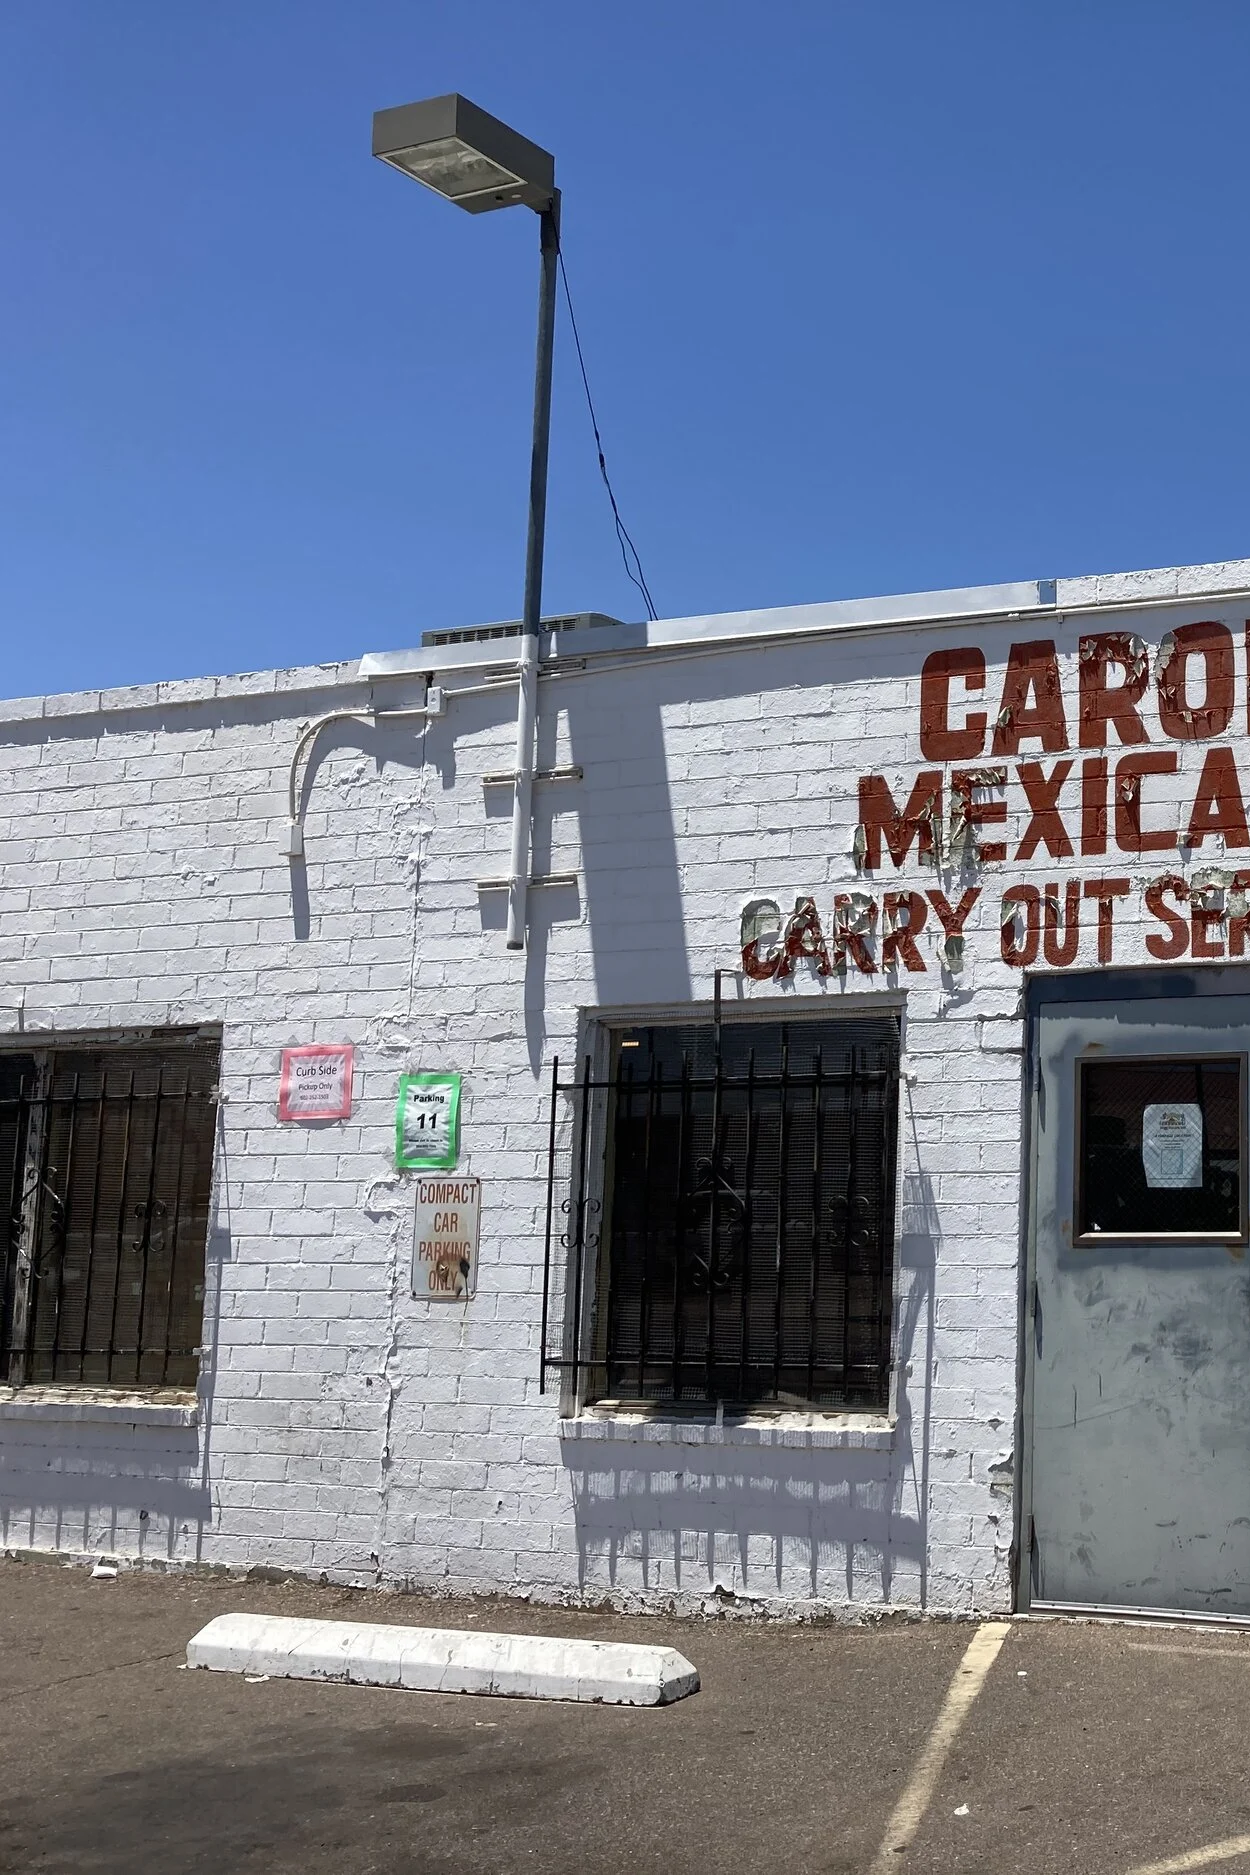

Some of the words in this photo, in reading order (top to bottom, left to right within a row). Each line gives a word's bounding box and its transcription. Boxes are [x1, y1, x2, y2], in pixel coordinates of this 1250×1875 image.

[741, 887, 982, 980] CARRY
[1001, 877, 1130, 967] OUT
[296, 1066, 317, 1077] Curb
[318, 1065, 338, 1076] Side
[298, 1083, 318, 1092] Pickup
[319, 1082, 333, 1091] Only
[413, 1094, 445, 1104] Parking
[417, 1113, 437, 1129] 11
[420, 1183, 477, 1204] COMPACT
[434, 1212, 458, 1232] CAR
[419, 1241, 471, 1261] PARKING
[428, 1270, 458, 1291] ONLY
